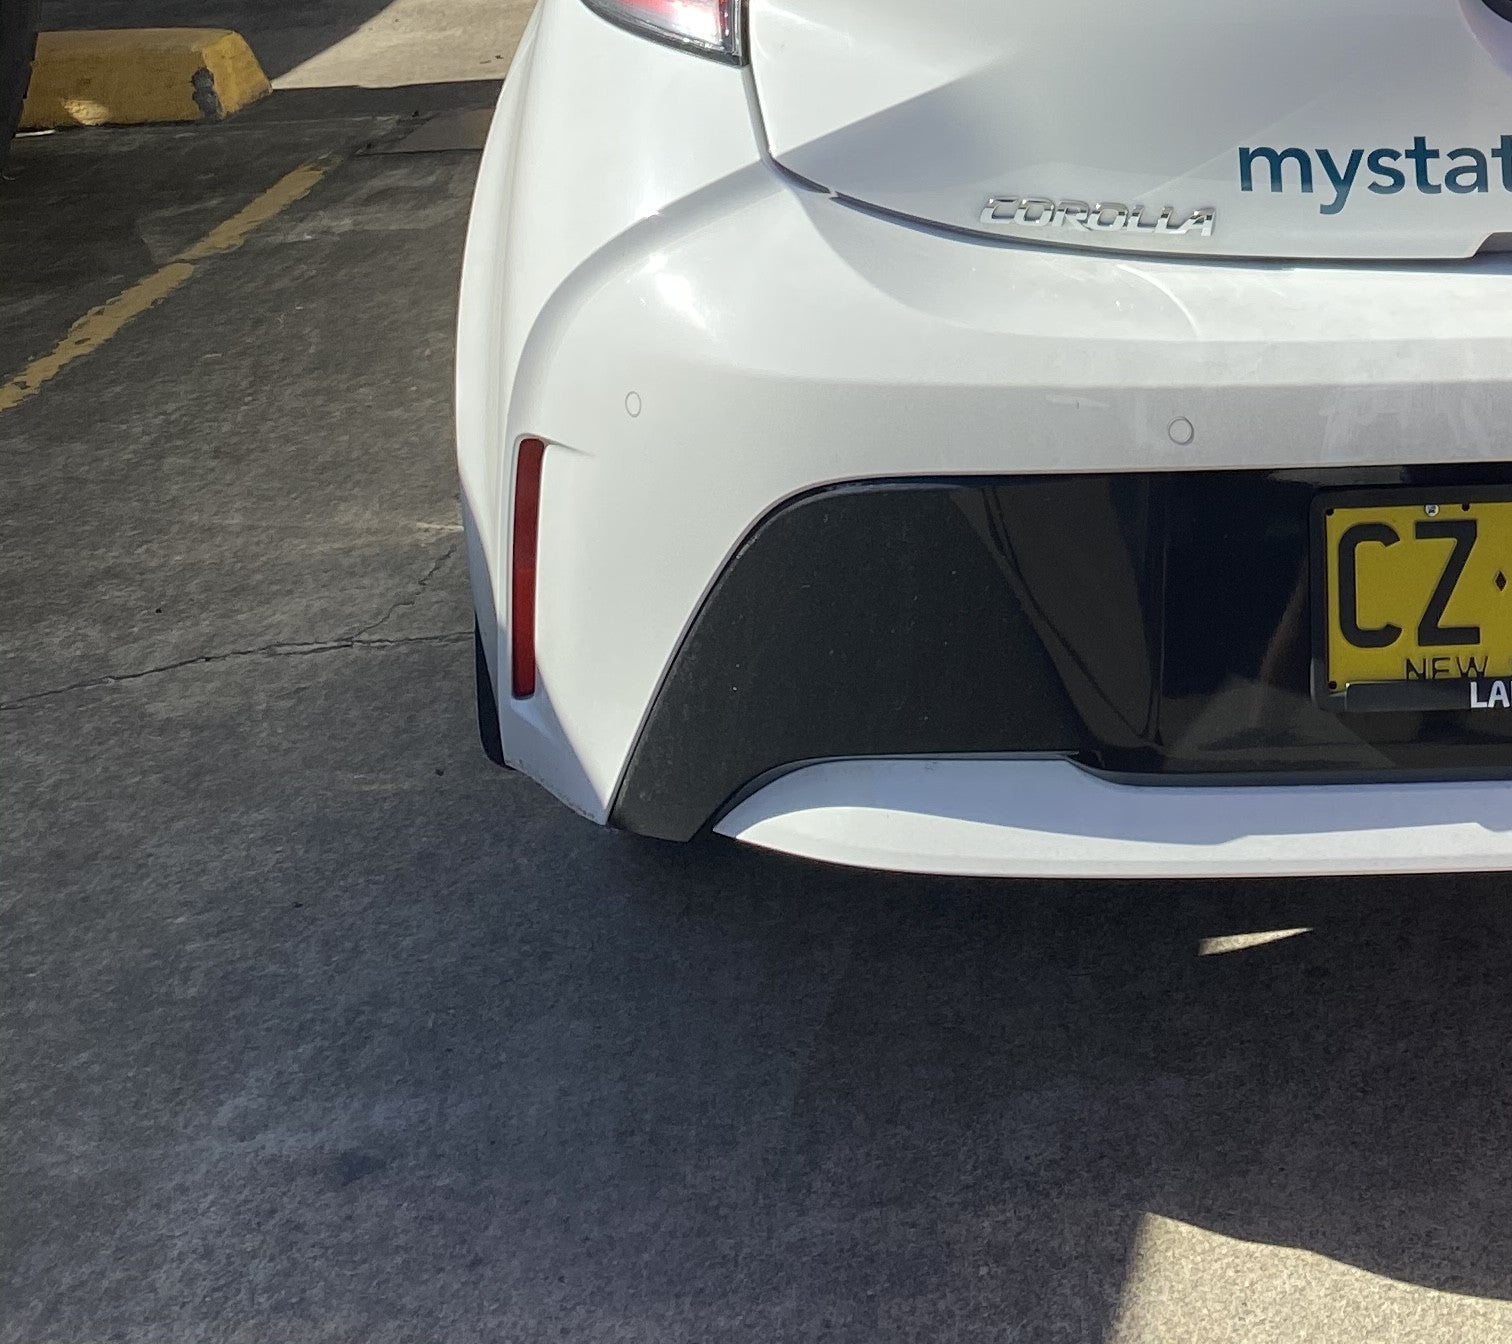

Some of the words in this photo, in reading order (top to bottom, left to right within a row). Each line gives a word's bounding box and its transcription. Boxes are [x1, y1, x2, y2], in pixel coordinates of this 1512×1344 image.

[979, 196, 1217, 237] COROLLA
[1337, 519, 1482, 648] CZ
[1404, 656, 1489, 680] NEW
